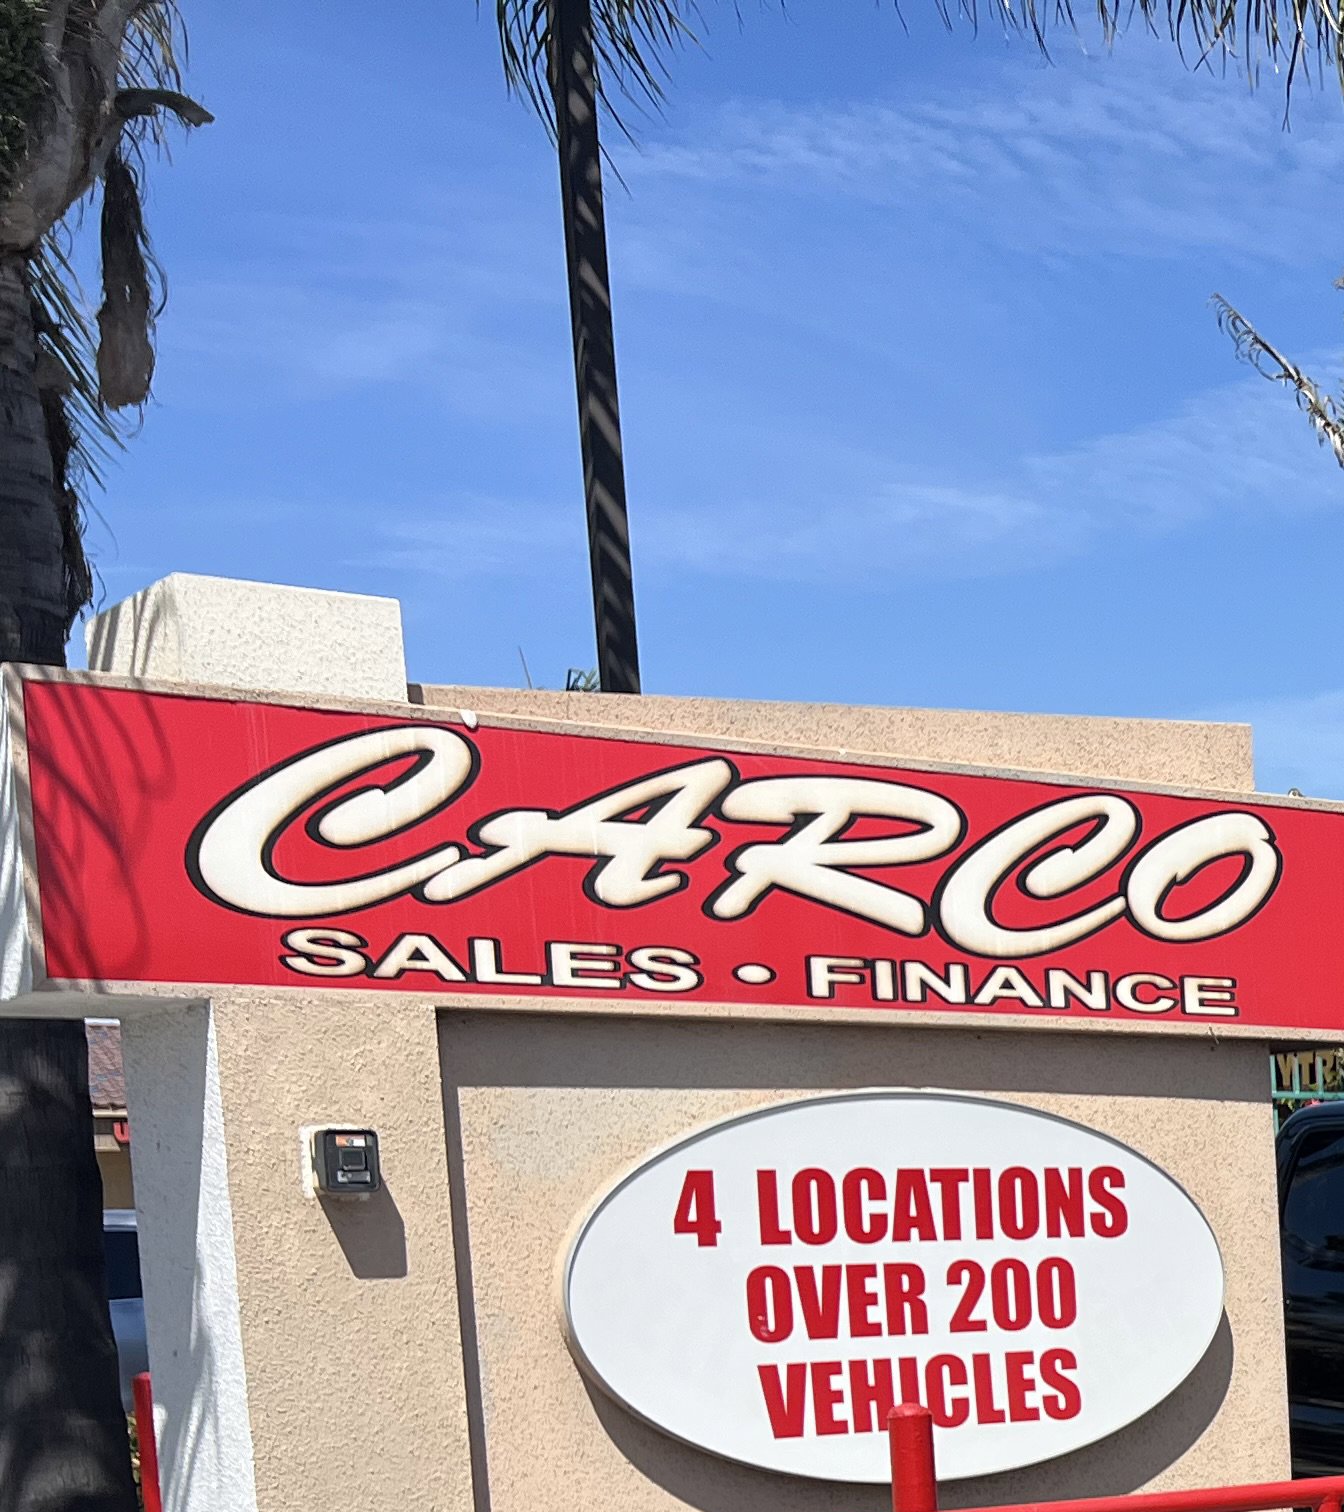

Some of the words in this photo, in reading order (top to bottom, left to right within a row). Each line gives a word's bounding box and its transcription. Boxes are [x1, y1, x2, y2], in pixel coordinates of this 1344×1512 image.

[186, 722, 1283, 960] CARCO
[278, 926, 704, 992] SALES
[806, 955, 1240, 1017] FINANCE
[673, 1170, 722, 1248] 4
[756, 1166, 1129, 1245] LOCATIONS
[745, 1263, 930, 1344] OVER
[946, 1257, 1078, 1332] 200
[757, 1348, 1082, 1440] VEHICLES
